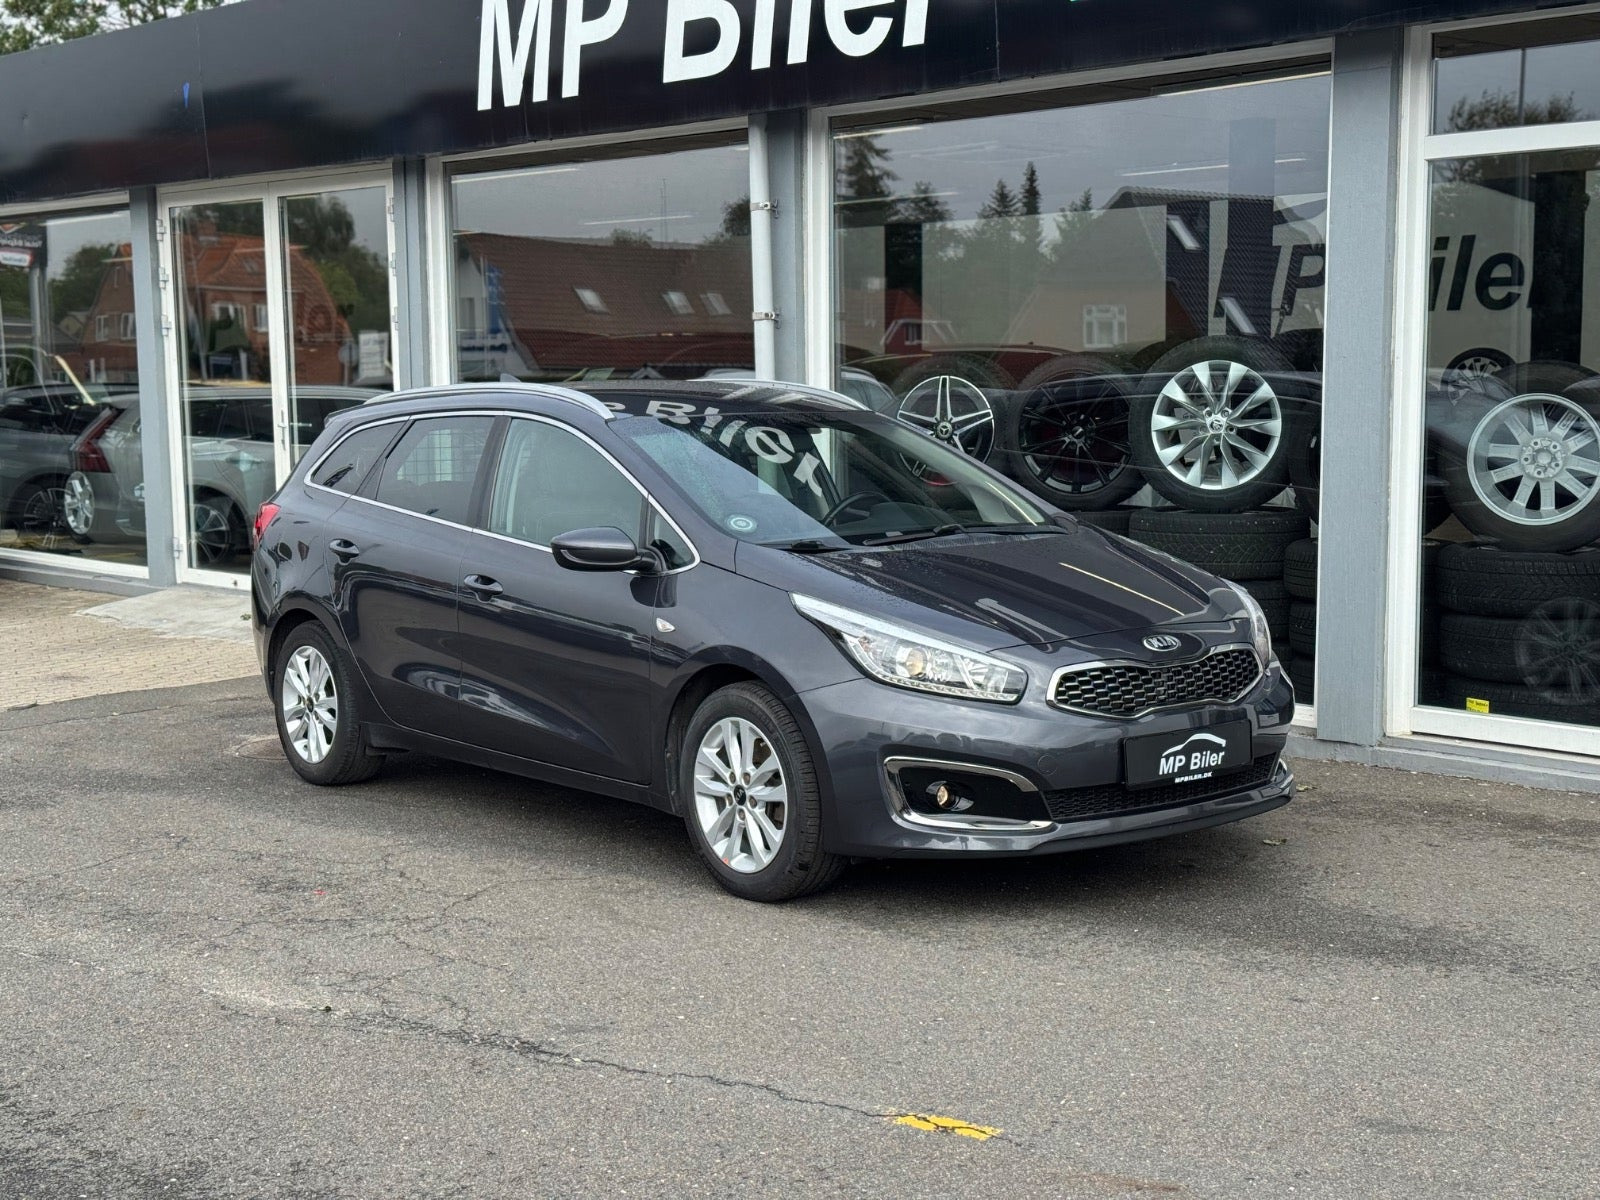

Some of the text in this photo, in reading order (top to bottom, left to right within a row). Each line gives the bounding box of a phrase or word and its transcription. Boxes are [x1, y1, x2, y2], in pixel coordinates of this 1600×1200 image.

[1148, 636, 1177, 648] KIA
[1159, 751, 1225, 775] MP Biler
